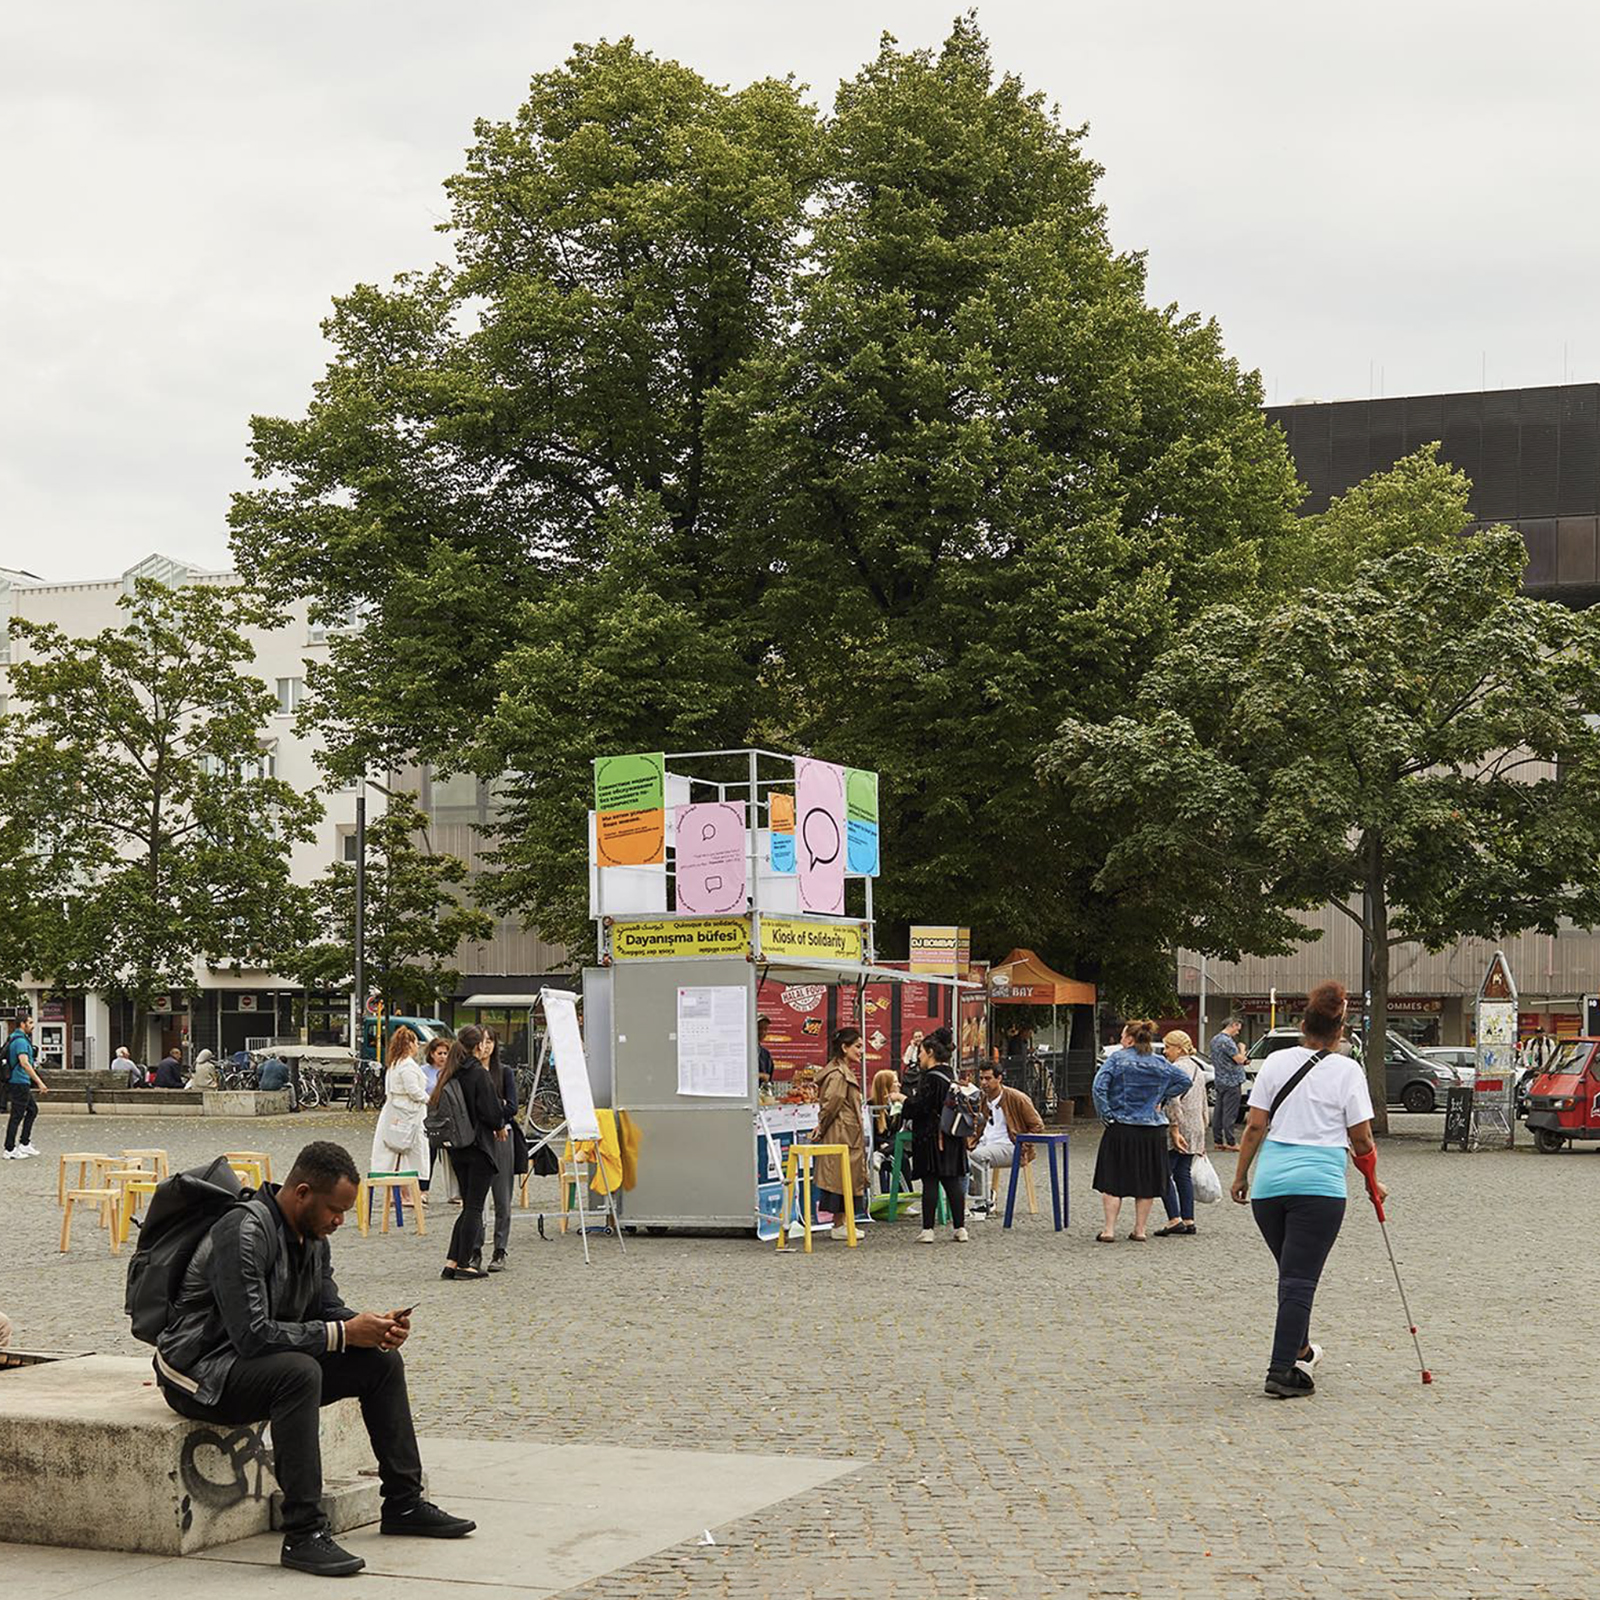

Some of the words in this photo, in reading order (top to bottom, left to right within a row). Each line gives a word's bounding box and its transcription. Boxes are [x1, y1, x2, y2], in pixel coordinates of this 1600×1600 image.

[625, 934, 694, 947] Dayanışma
[697, 928, 737, 942] büfesi
[772, 928, 797, 944] Kiosk
[797, 931, 807, 946] of
[807, 932, 846, 951] Solidarity
[783, 988, 804, 1001] HALAL
[805, 984, 827, 996] FOOD
[1386, 1001, 1422, 1011] OMMES
